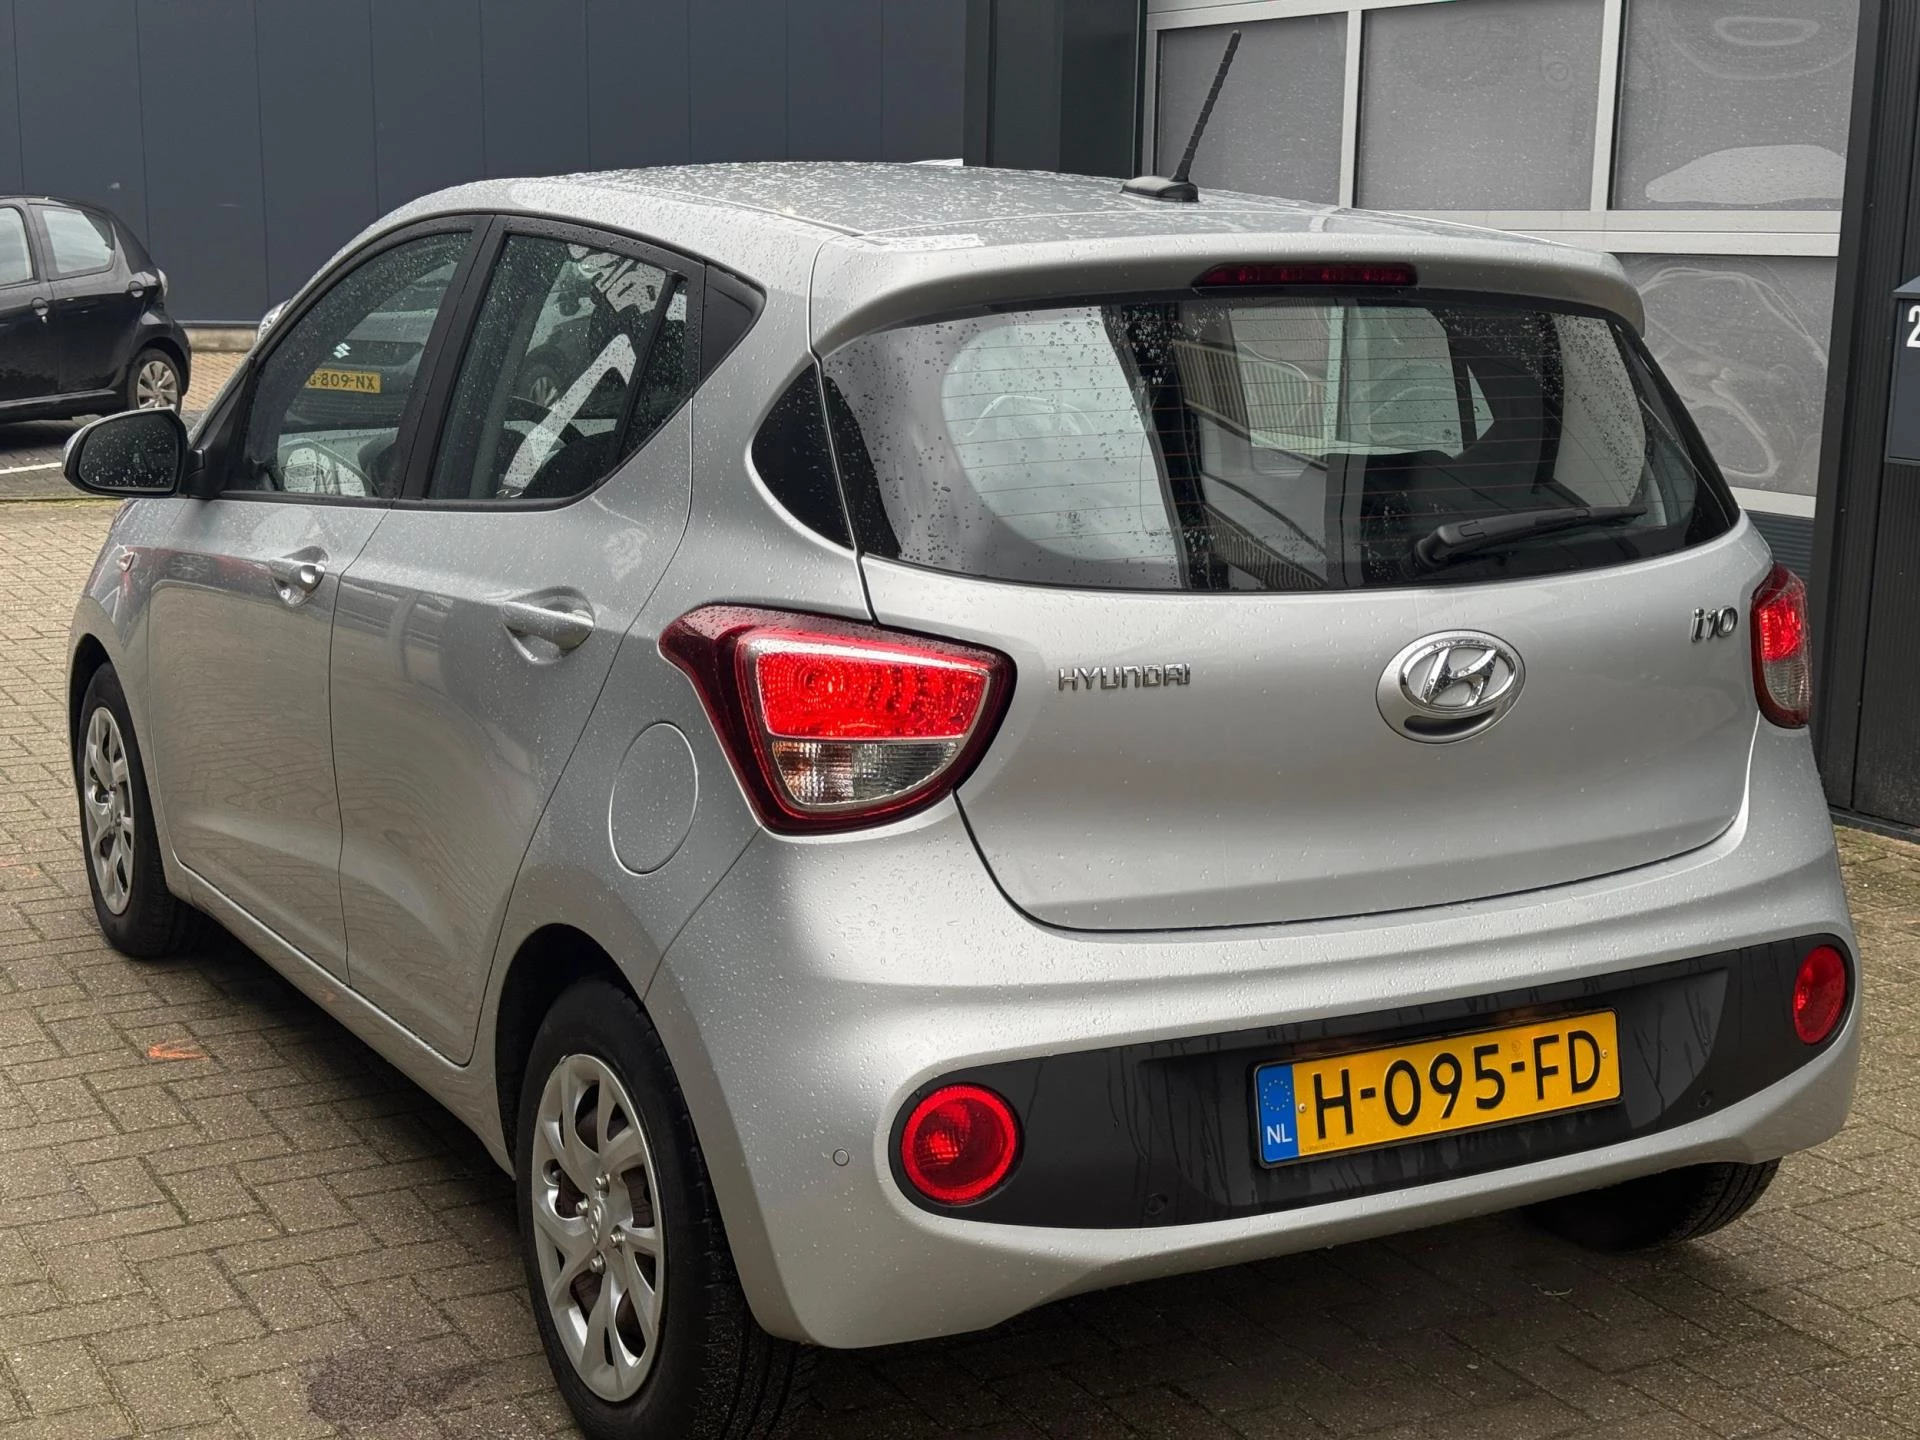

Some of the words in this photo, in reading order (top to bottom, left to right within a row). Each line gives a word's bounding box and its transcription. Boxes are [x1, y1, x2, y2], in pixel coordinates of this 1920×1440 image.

[1690, 606, 1738, 643] i10
[1058, 663, 1191, 691] HYUNDAI
[1266, 1123, 1293, 1146] NL
[1312, 1029, 1602, 1140] H-095-FD
